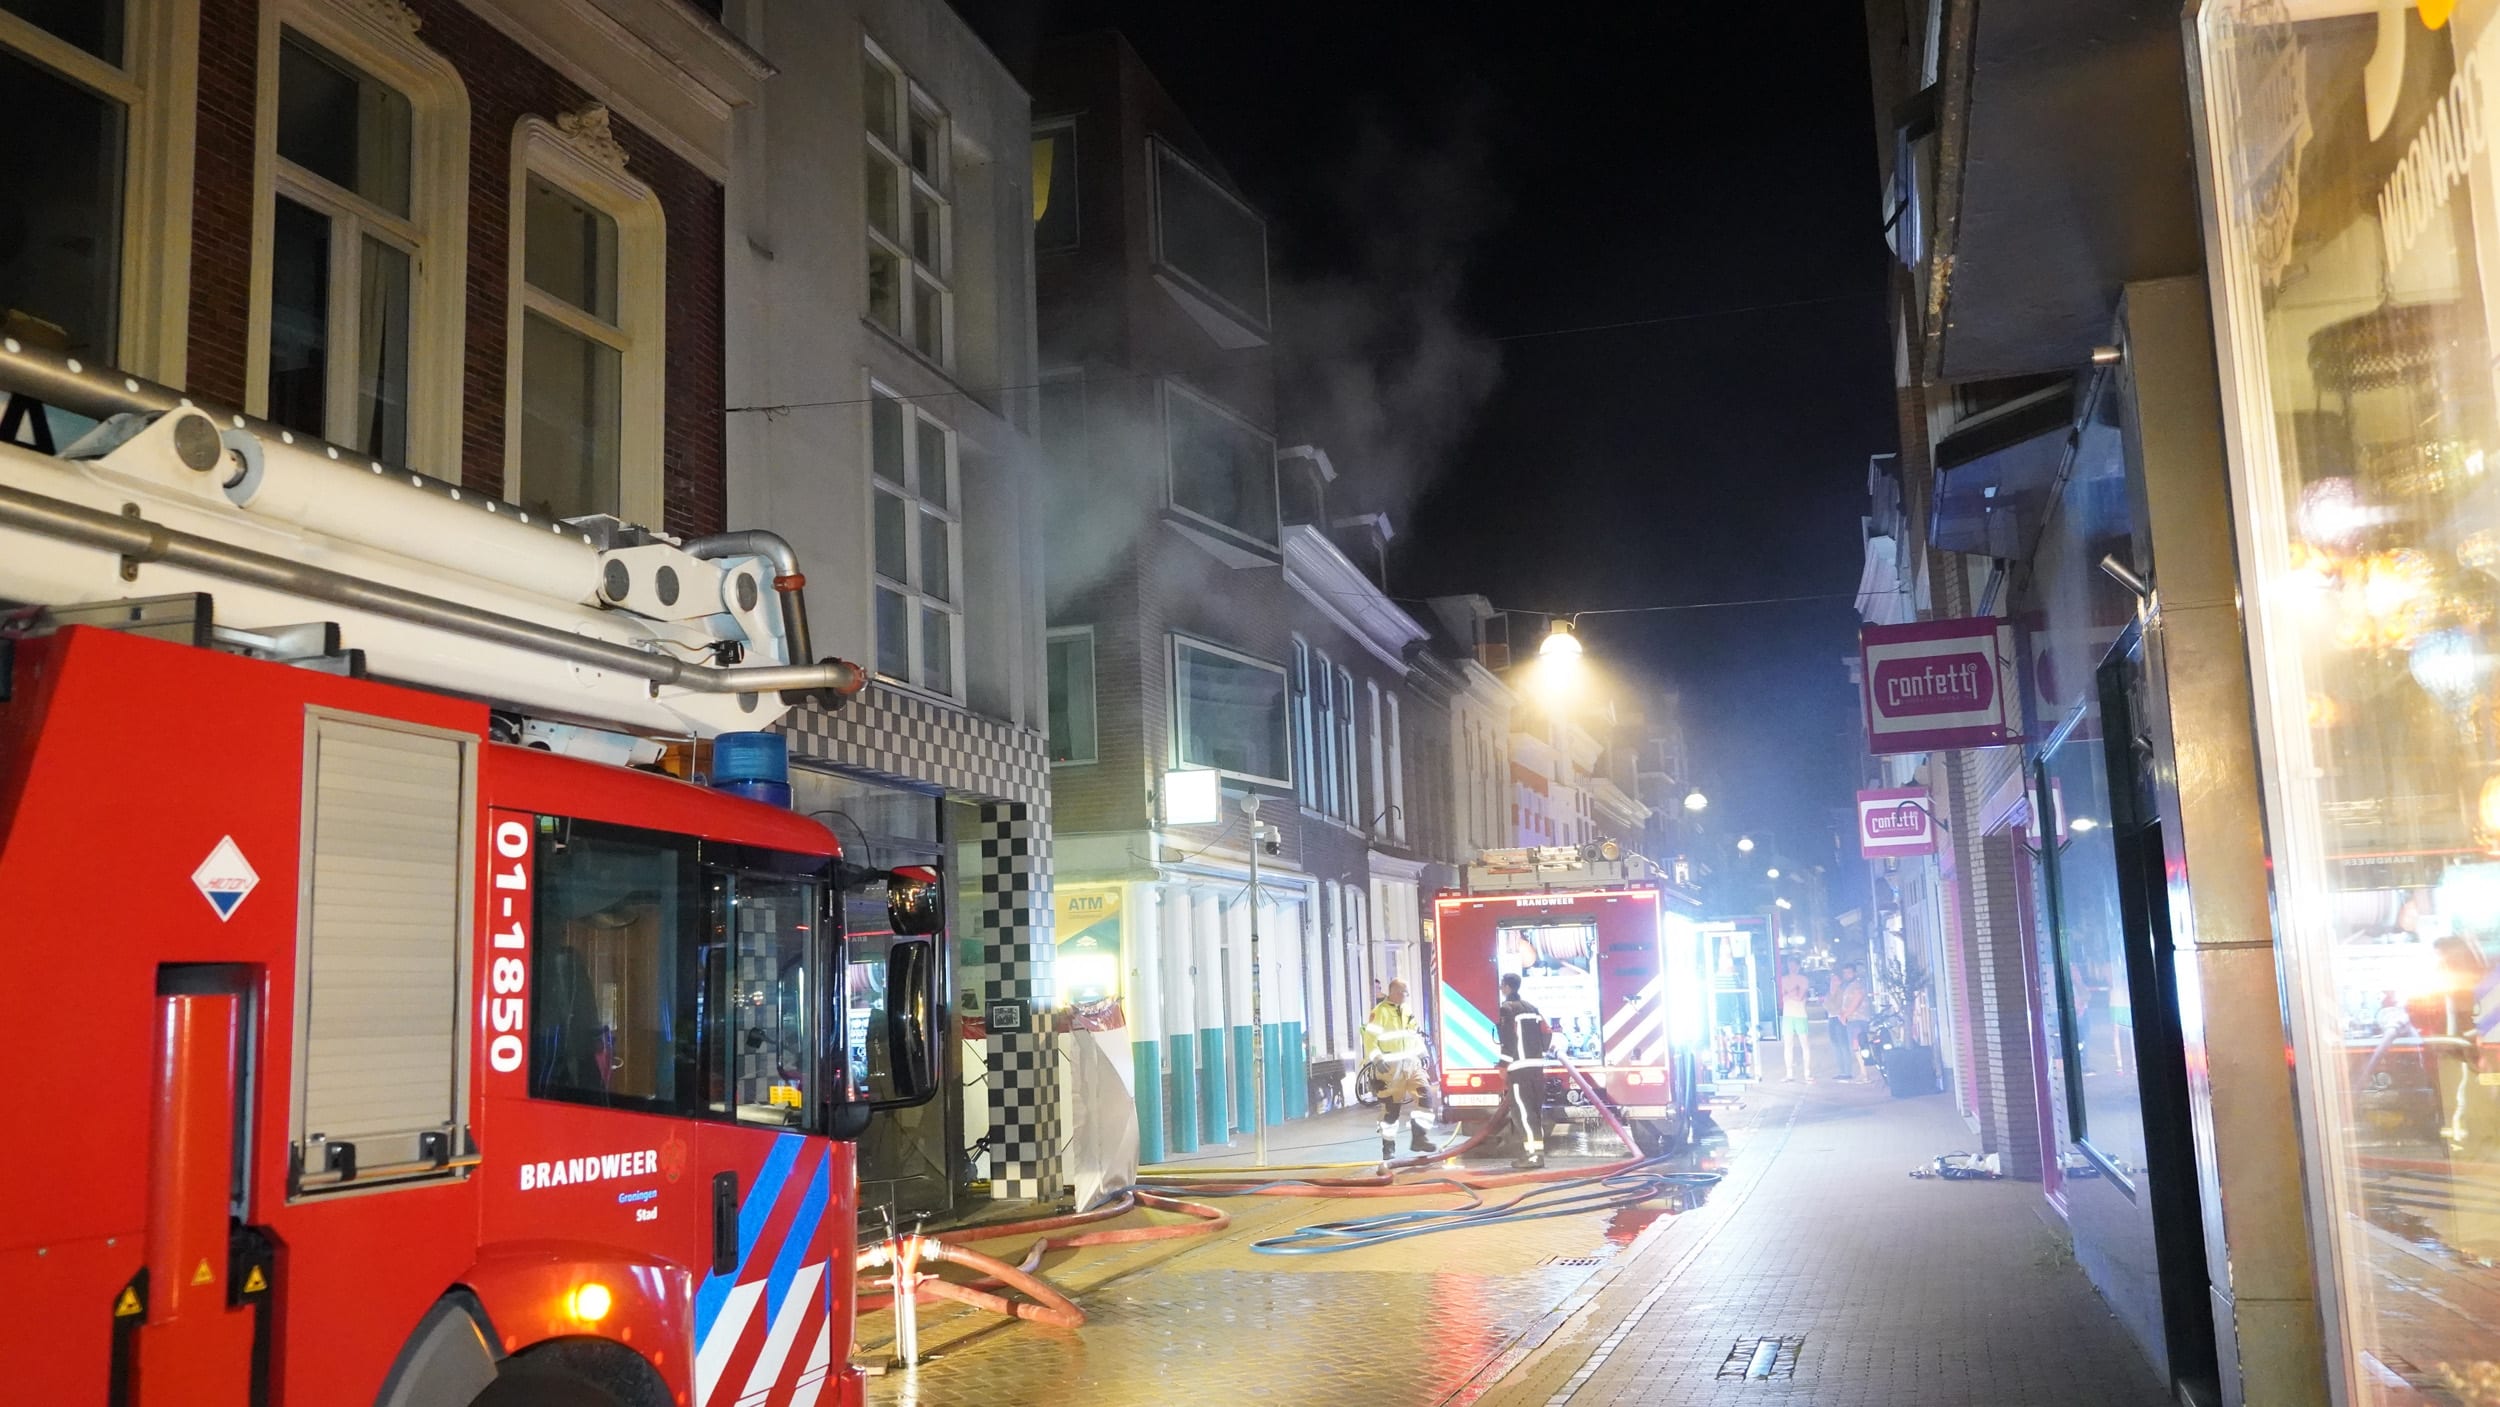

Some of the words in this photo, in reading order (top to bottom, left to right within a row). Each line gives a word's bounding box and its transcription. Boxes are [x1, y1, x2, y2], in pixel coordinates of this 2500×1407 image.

[1887, 662, 1978, 706] confetti
[1068, 896, 1103, 911] ATM
[1516, 897, 1574, 907] BRANDWEER
[490, 821, 529, 1073] 01-1850
[520, 1149, 658, 1191] BRANDWEER
[618, 1189, 658, 1204] Groningen
[635, 1206, 658, 1222] Stad
